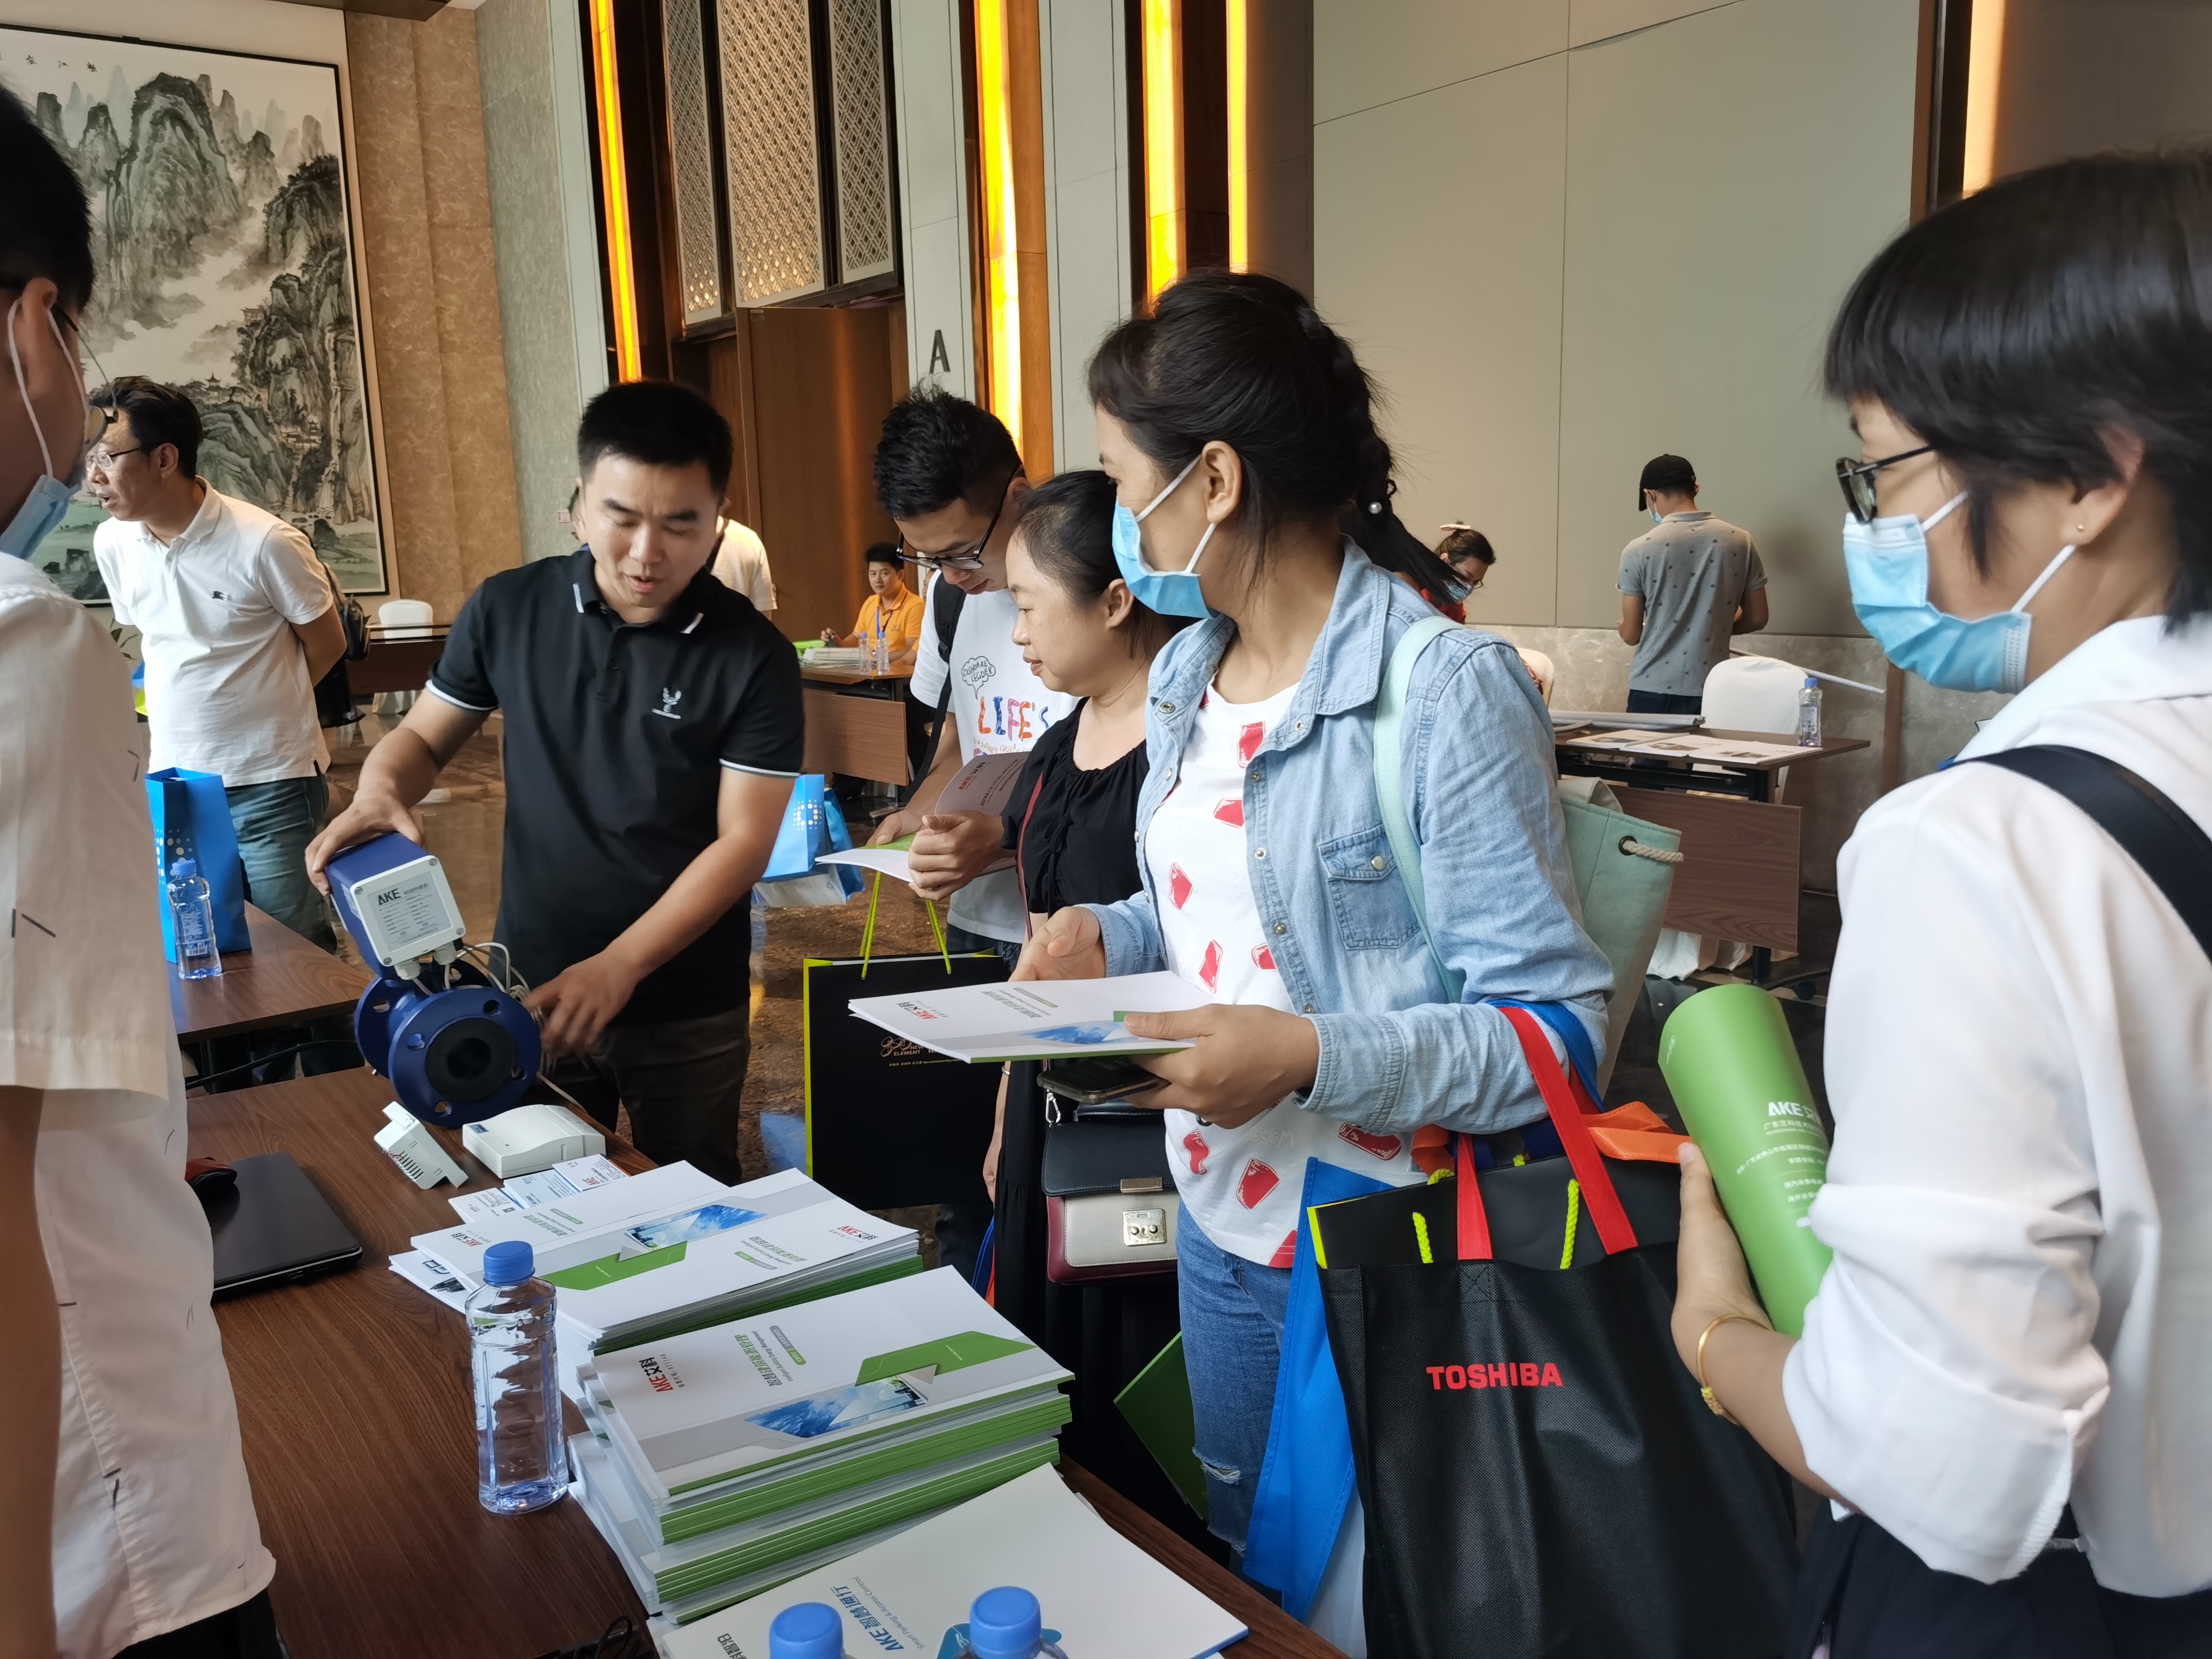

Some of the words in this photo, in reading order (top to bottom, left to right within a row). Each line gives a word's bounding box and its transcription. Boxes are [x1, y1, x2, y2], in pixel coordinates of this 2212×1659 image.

[929, 329, 951, 374] A
[378, 888, 401, 905] AKE
[734, 1333, 783, 1387] 智慧建筑能源管理
[638, 1357, 674, 1392] AKE艾科
[1426, 1362, 1563, 1390] TOSHIBA
[852, 1576, 873, 1597] Control
[870, 1595, 888, 1612] Access
[889, 1615, 911, 1636] Parking
[909, 1634, 925, 1649] Smart
